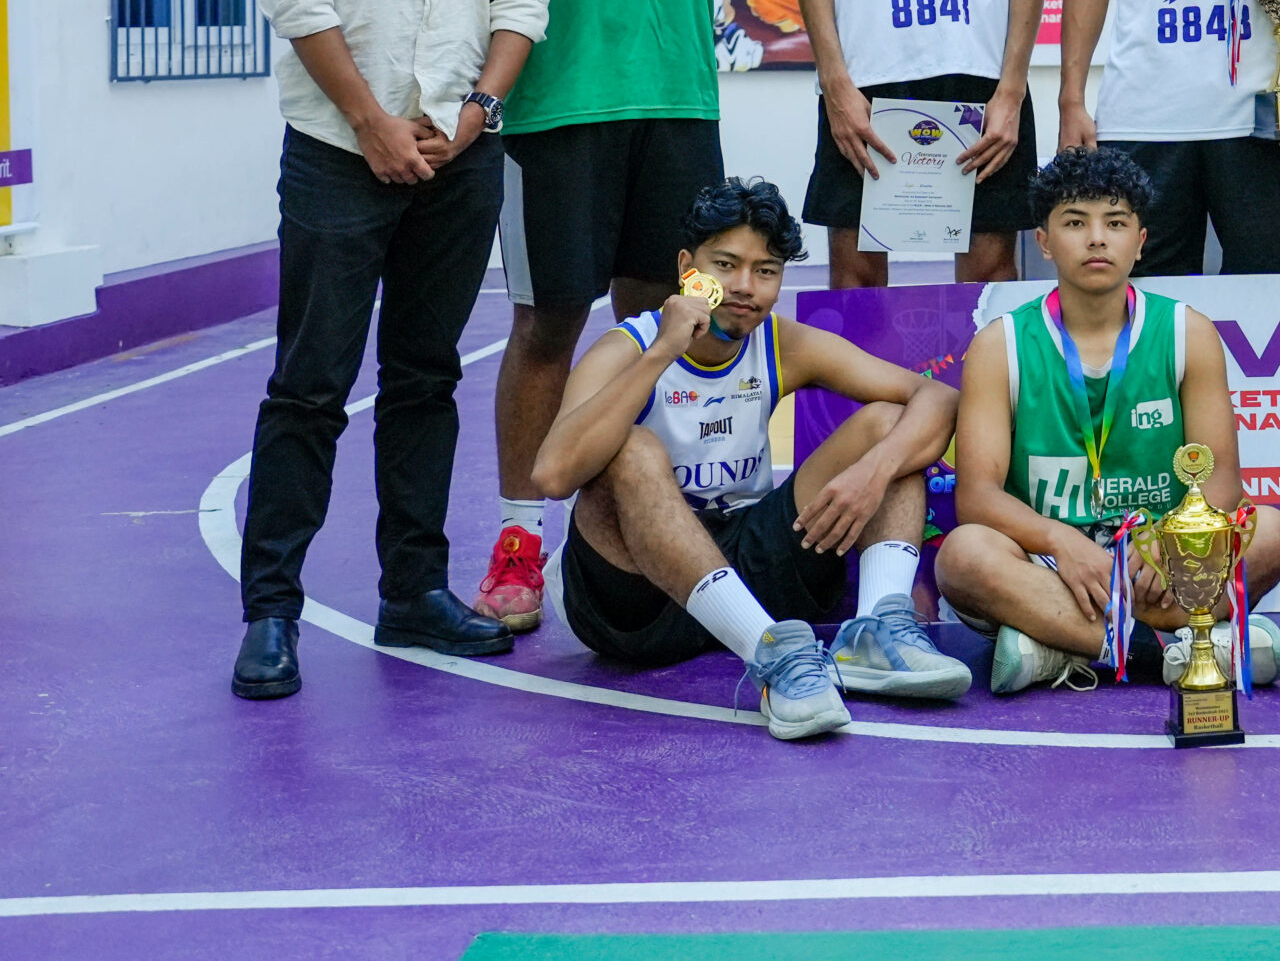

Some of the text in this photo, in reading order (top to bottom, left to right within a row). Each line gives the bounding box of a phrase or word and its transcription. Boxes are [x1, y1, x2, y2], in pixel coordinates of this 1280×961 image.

[901, 151, 945, 169] Victory
[699, 416, 733, 440] TAPOUT
[673, 448, 765, 489] OUND
[1105, 488, 1171, 508] OLLEGE
[1103, 502, 1172, 516] ATHMNDU
[1187, 714, 1230, 724] RUNNER-UP
